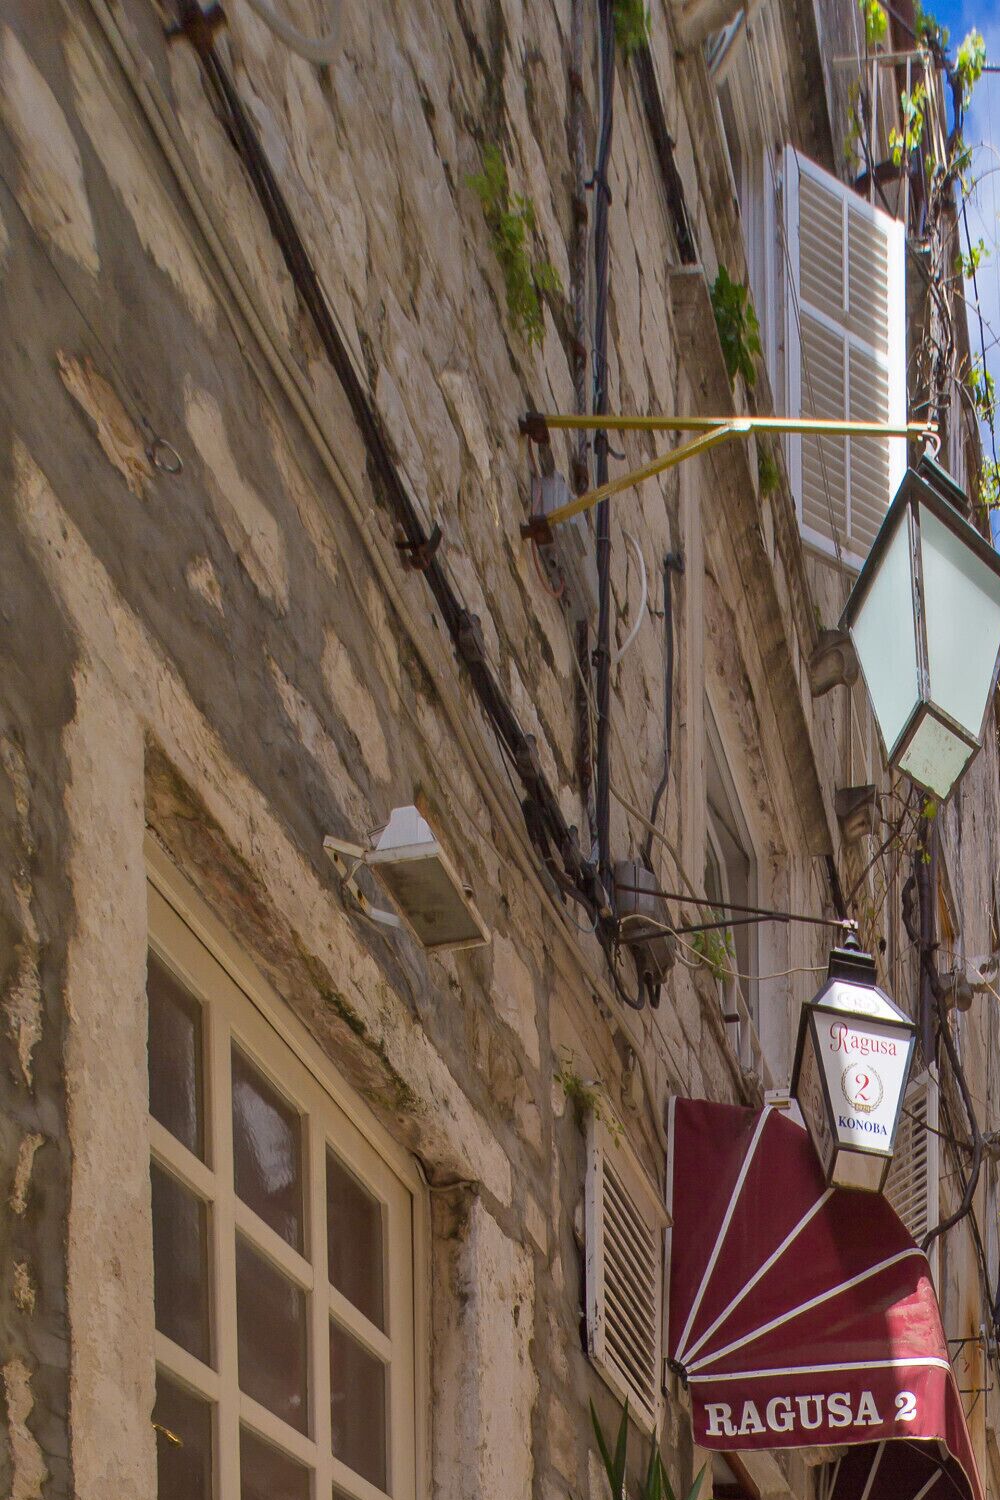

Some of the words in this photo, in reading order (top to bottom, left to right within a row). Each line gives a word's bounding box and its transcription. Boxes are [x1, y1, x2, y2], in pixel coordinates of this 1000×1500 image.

[829, 1021, 897, 1056] Ragusa
[855, 1073, 870, 1101] 2
[838, 1115, 888, 1136] KONOBA
[704, 1391, 883, 1436] RAGUSA
[895, 1391, 917, 1422] 2
